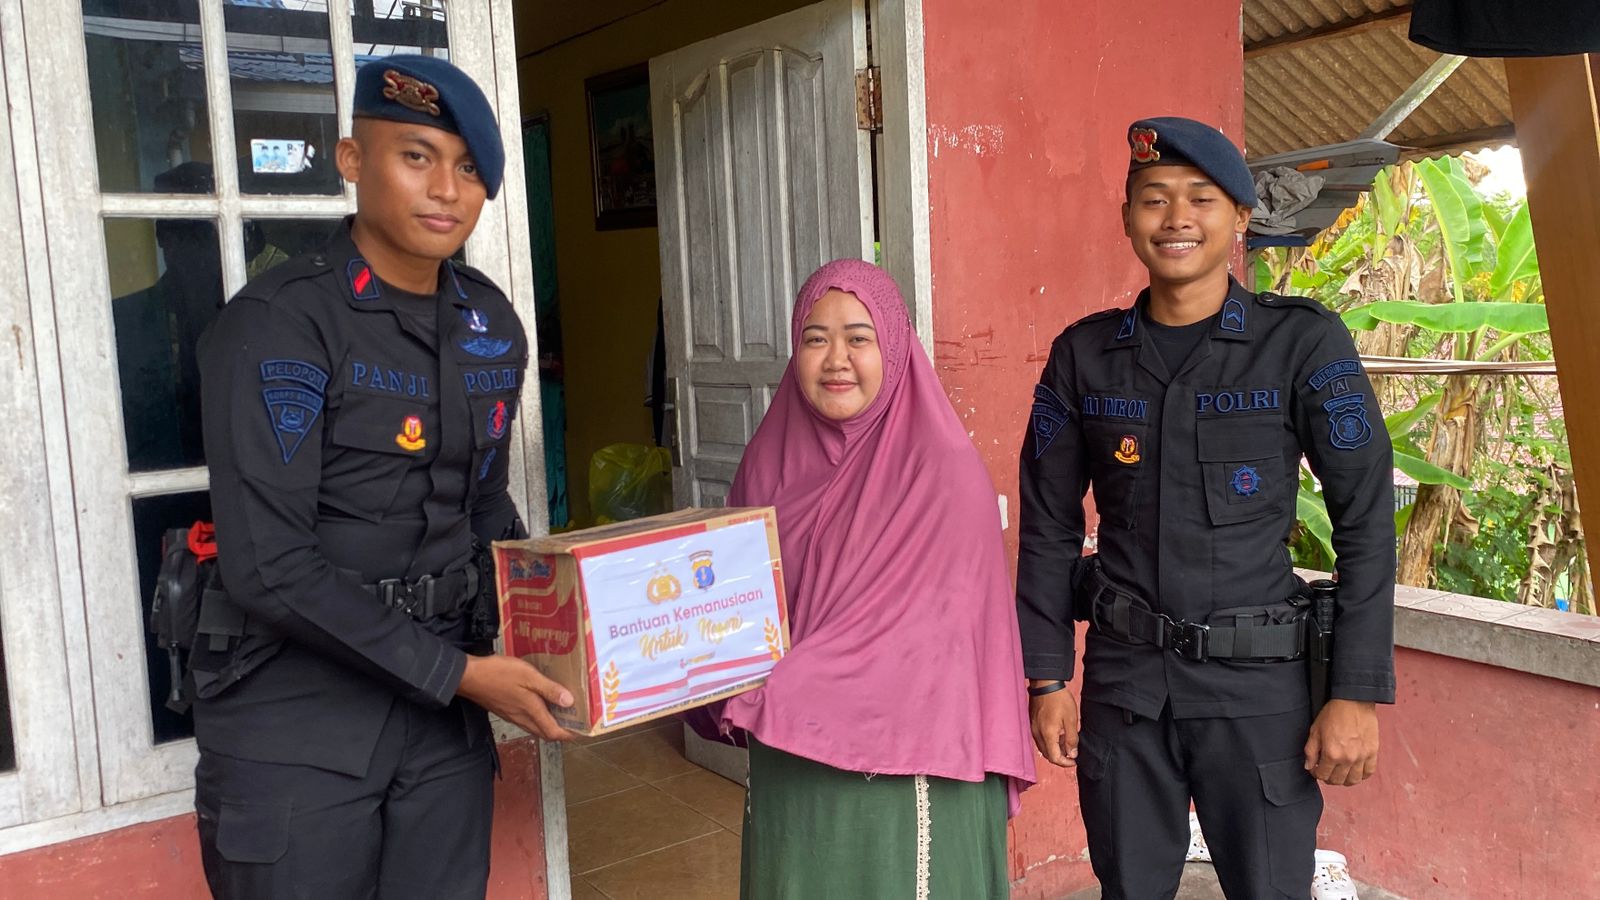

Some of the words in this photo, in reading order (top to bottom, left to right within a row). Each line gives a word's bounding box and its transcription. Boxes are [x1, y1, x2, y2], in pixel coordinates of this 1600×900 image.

[352, 362, 429, 397] PANJI
[464, 368, 517, 392] POLRI
[1335, 381, 1346, 393] A
[1103, 397, 1148, 418] IMRON
[1197, 389, 1280, 413] POLRI
[609, 613, 671, 640] Bantuan
[673, 588, 763, 622] Kemanusiaan
[639, 624, 689, 661] Untuk
